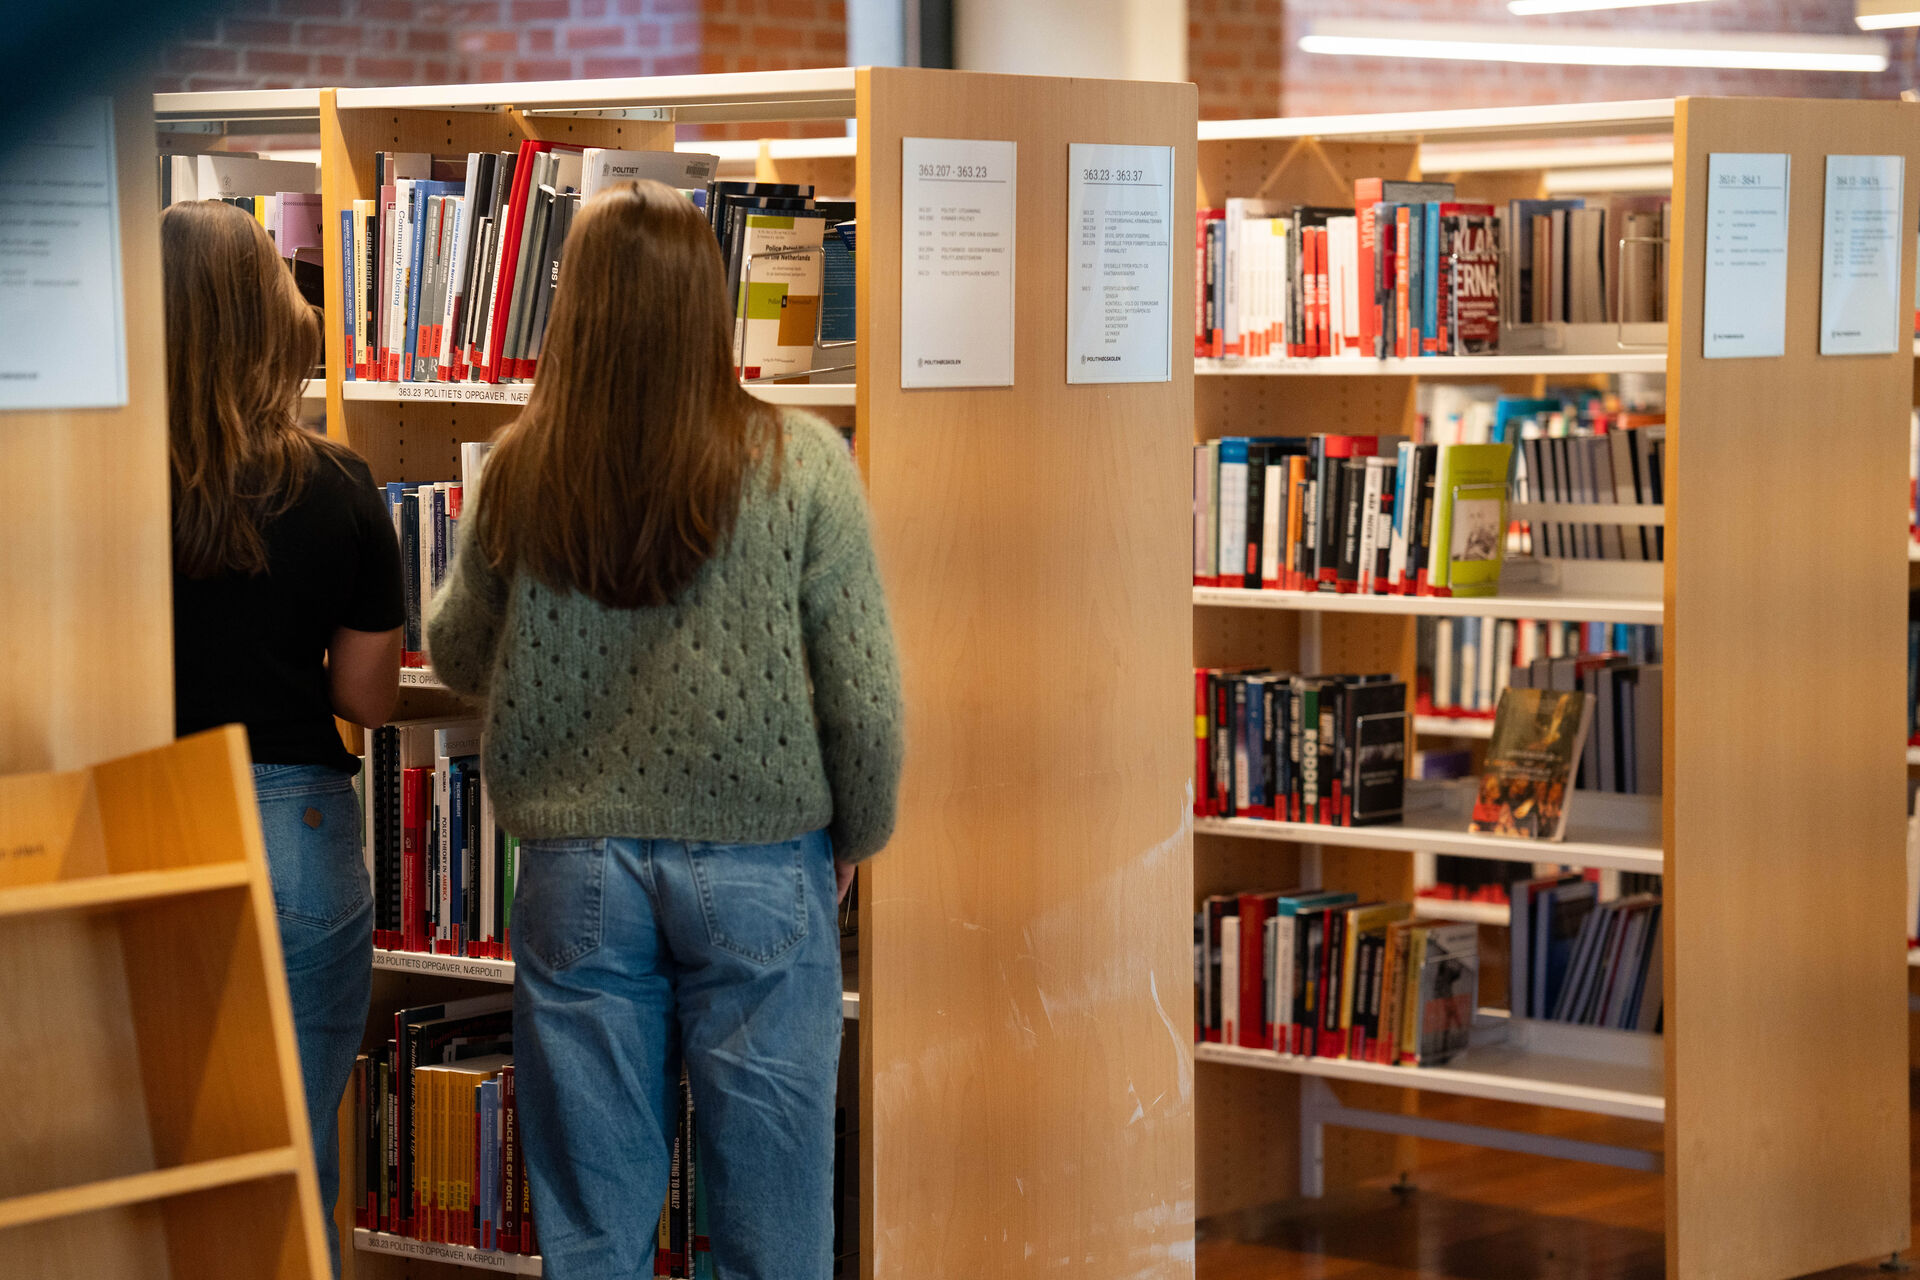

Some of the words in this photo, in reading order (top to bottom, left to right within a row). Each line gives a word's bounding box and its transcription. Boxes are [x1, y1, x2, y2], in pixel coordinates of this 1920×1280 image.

[612, 166, 639, 174] POLITIET
[918, 164, 951, 177] 363.207
[957, 166, 987, 179] 363.23
[1083, 169, 1110, 181] 363.23
[1116, 170, 1143, 182] 363.37
[395, 210, 406, 267] Community
[765, 244, 782, 252] Police
[780, 254, 811, 262] Netherlands
[551, 260, 559, 282] PBS
[393, 267, 403, 306] Policing
[398, 387, 422, 398] 363.23
[424, 388, 462, 399] POLITIETS
[465, 390, 508, 401] OPPGAVER,
[386, 956, 421, 969] POLITIETS
[421, 960, 461, 975] OPPGAVER,
[463, 966, 503, 978] NÆRPOLITI
[506, 1107, 514, 1141] POLICE
[506, 1163, 513, 1178] OF
[671, 1178, 680, 1188] TO
[505, 1178, 513, 1213] FORCE
[671, 1189, 680, 1210] KILL?
[368, 1238, 390, 1250] 363.23
[390, 1241, 425, 1255] POLITIETS
[425, 1247, 466, 1262] OPPGAVER,
[466, 1253, 506, 1266] NÆRPOLITI
